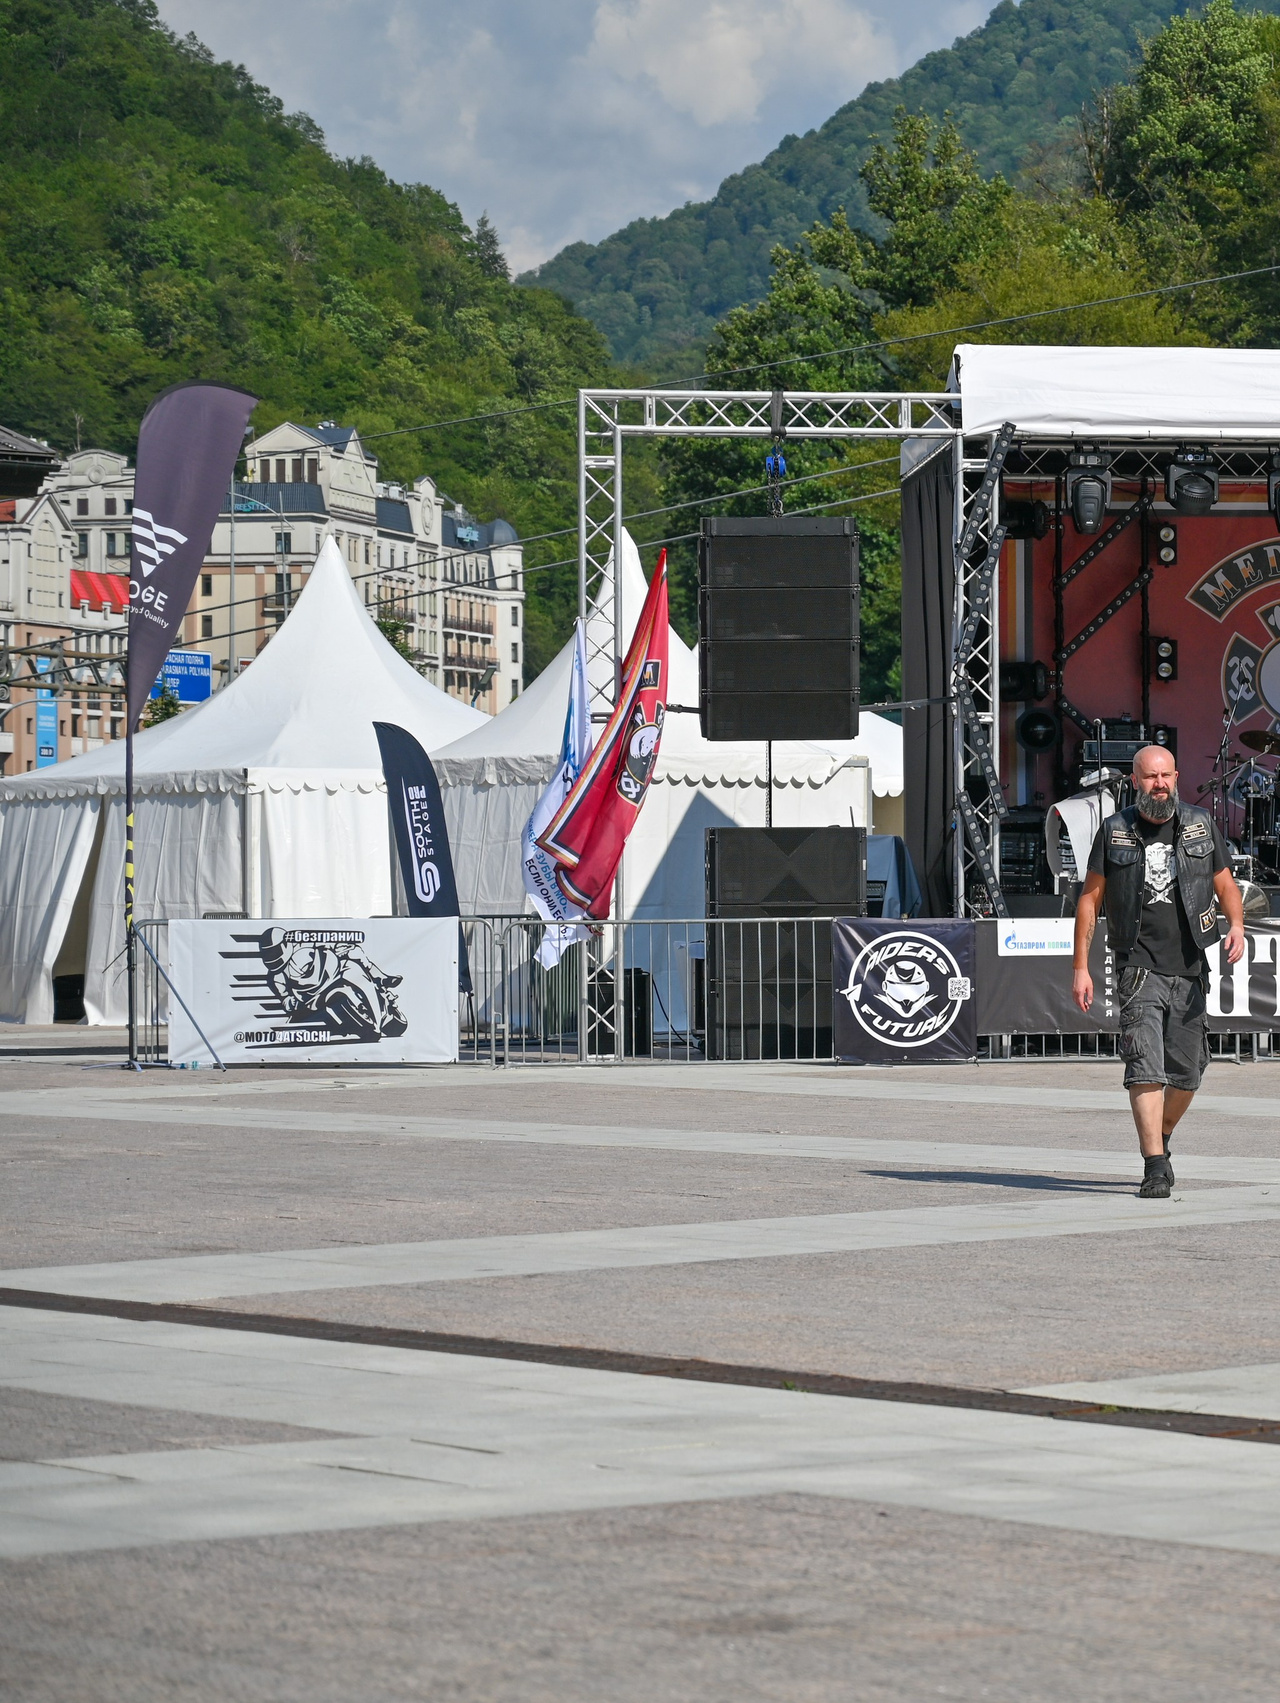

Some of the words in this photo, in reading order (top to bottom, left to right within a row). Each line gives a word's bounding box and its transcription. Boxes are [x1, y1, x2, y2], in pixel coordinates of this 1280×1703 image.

[129, 580, 168, 612] OGE
[144, 610, 169, 628] Quality
[165, 654, 184, 664] РАСНАЯ
[189, 667, 210, 676] POLYANA
[410, 800, 427, 858] SOUTH
[421, 801, 435, 856] STAGE
[525, 859, 544, 887] ЕСЛИ
[540, 887, 557, 911] ОНИ
[285, 930, 363, 943] #безграниц
[1017, 941, 1045, 949] ГАЗПРОМ
[863, 941, 950, 981] RIDERS
[860, 1001, 951, 1038] FUTURE
